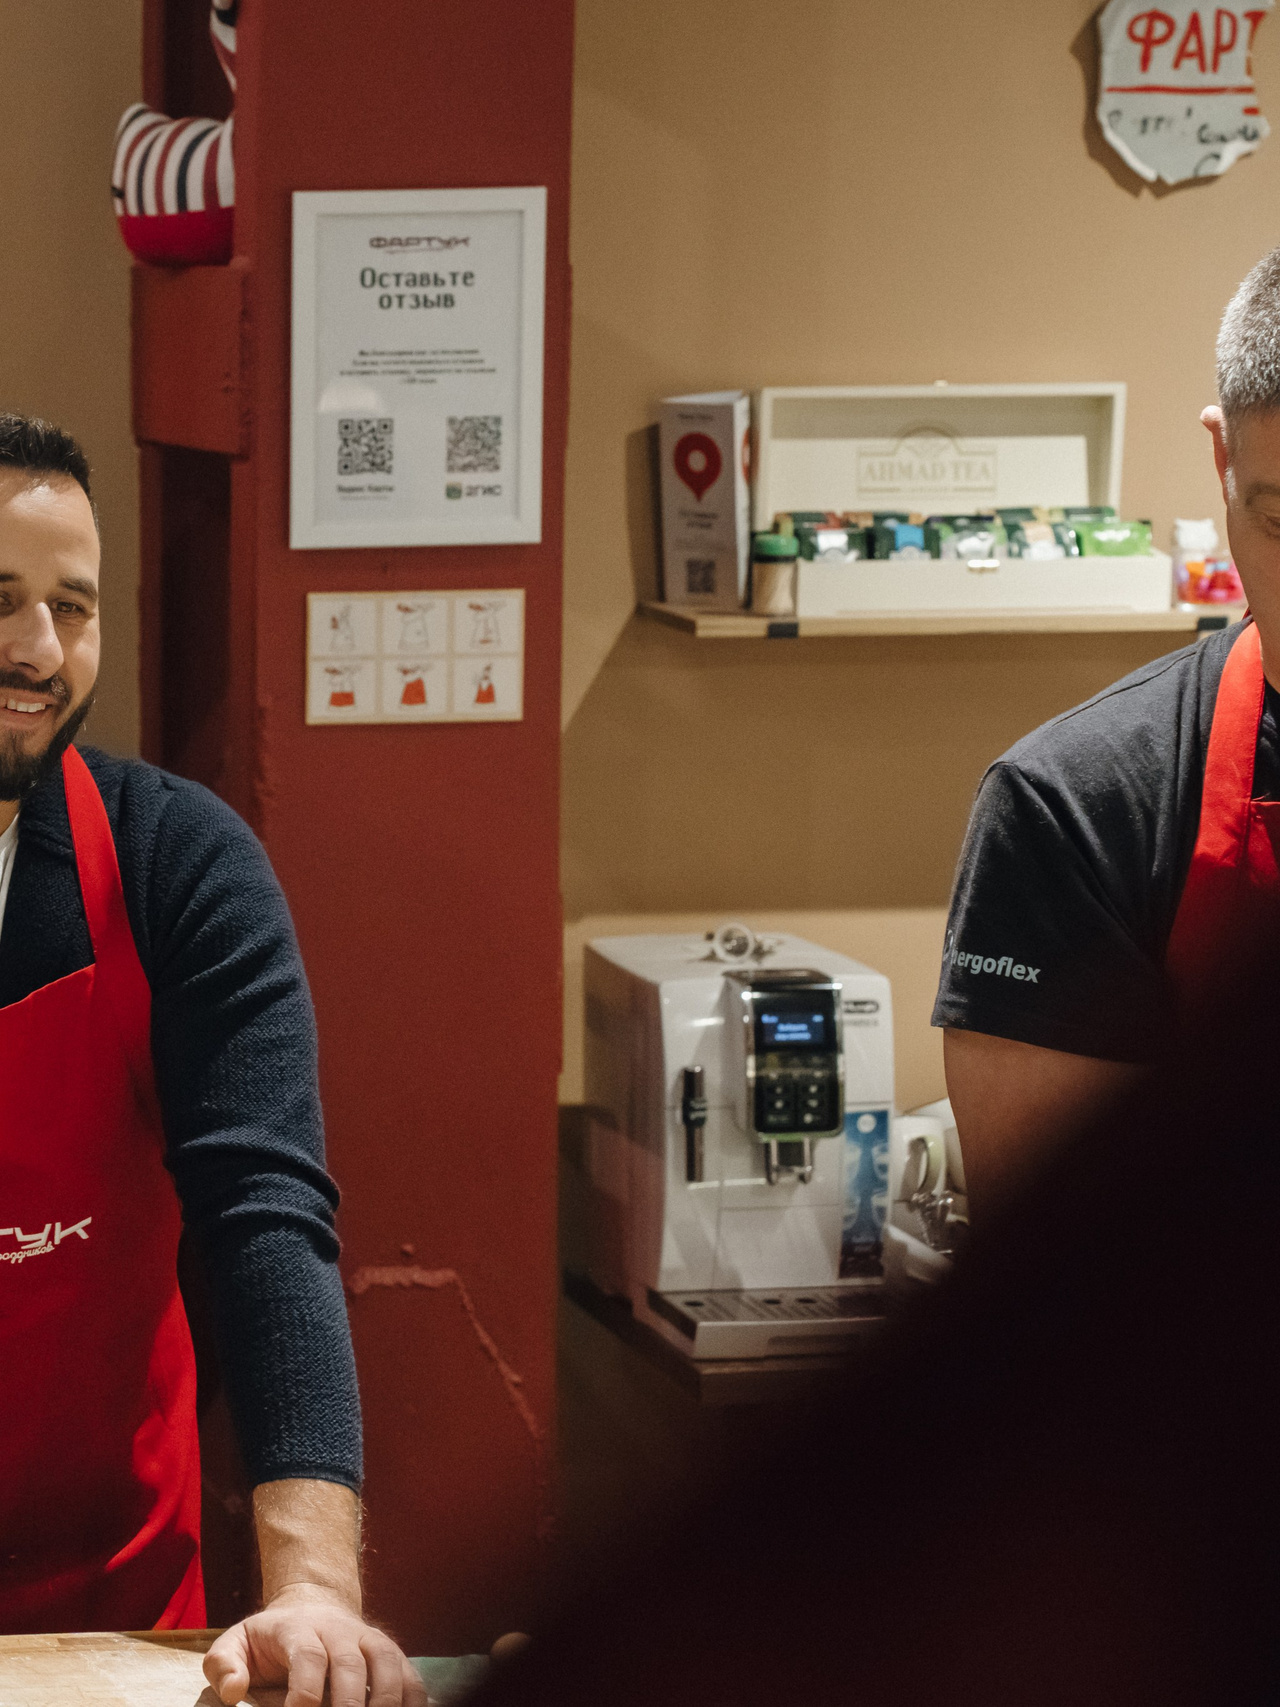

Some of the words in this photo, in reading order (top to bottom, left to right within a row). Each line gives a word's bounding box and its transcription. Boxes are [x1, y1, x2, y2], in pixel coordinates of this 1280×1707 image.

[369, 236, 470, 249] ФАРТУК
[360, 267, 475, 288] Оставьте
[378, 293, 455, 309] отзыв
[865, 461, 946, 481] AHMAD
[951, 460, 990, 480] TEA
